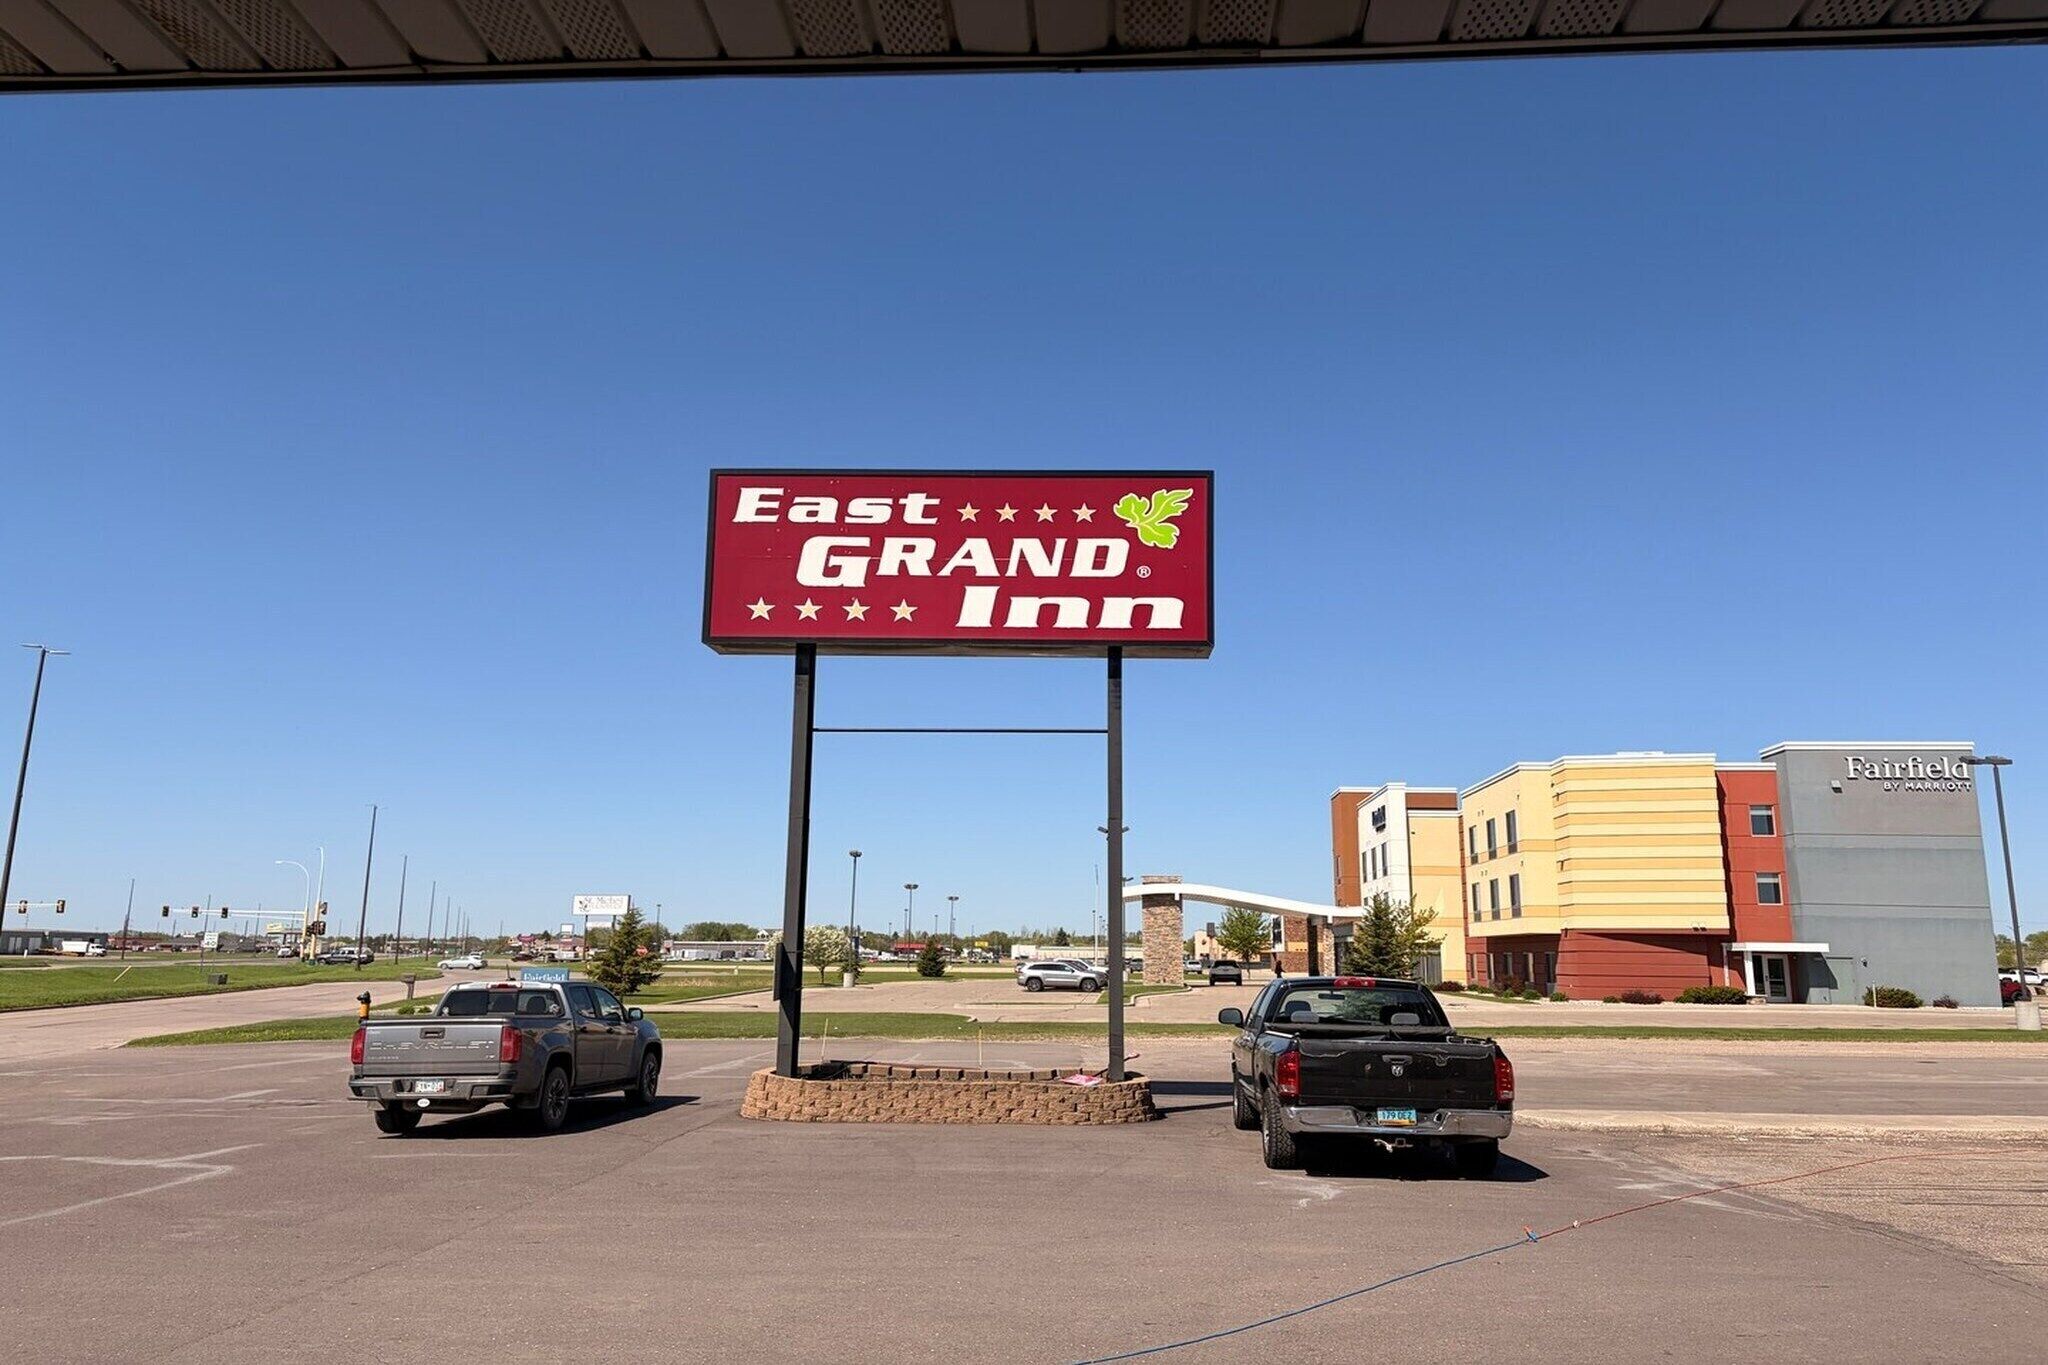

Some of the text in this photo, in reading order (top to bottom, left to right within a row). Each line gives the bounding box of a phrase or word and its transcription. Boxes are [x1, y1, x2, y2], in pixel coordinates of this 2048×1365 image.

[732, 487, 941, 525] East
[796, 535, 1130, 588] GRAND
[955, 585, 1185, 629] Inn
[1845, 756, 1970, 780] Fairfield
[1883, 781, 1972, 792] BY MARRIOTT
